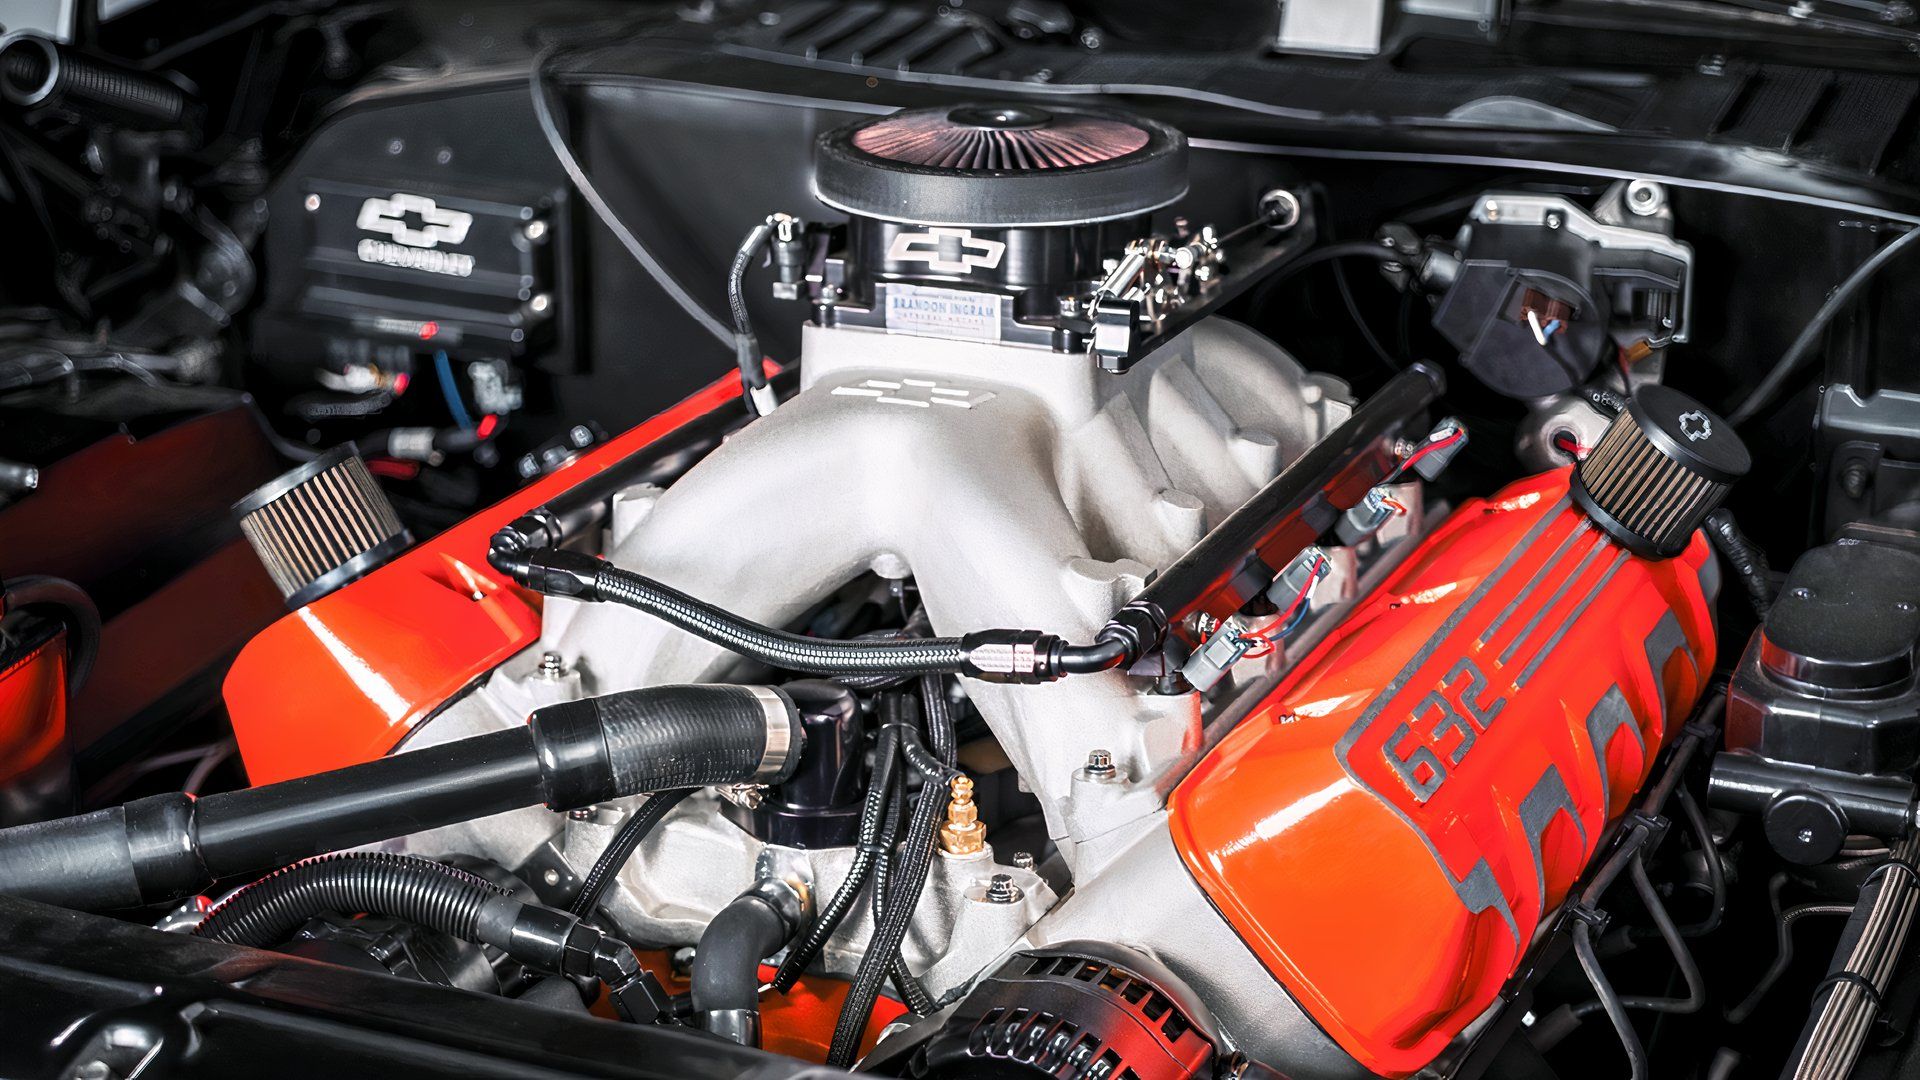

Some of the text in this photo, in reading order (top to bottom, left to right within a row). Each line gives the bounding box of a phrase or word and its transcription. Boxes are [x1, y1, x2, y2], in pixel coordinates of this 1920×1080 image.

[893, 297, 995, 318] BRANDON INGRAM
[1382, 656, 1508, 803] 632
